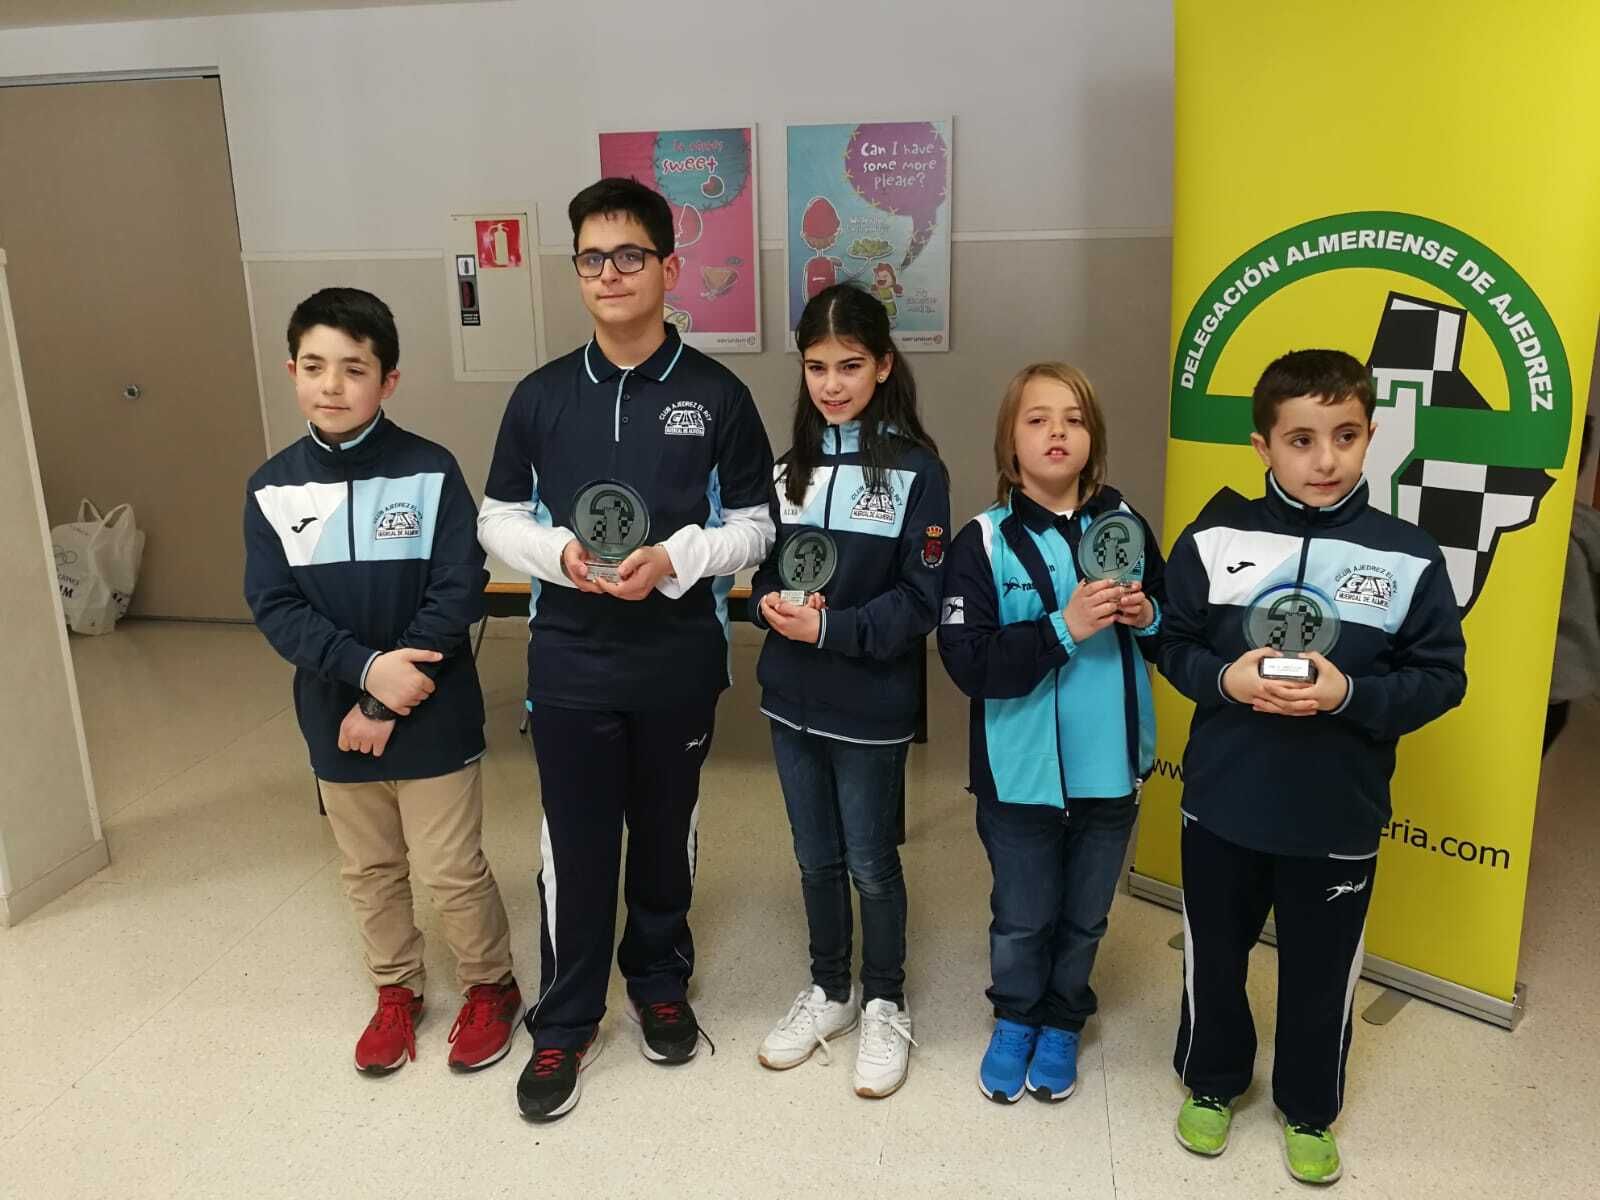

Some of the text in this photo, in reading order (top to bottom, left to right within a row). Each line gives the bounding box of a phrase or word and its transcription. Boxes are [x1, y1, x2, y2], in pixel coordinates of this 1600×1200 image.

[860, 141, 935, 156] Can I have
[661, 156, 718, 175] sweet
[863, 160, 937, 173] some more
[873, 172, 926, 190] please?
[1180, 229, 1554, 412] DELEGACIÓN ALMERIENSE DE AJEDREZ
[1353, 564, 1386, 575] AJEDREZ
